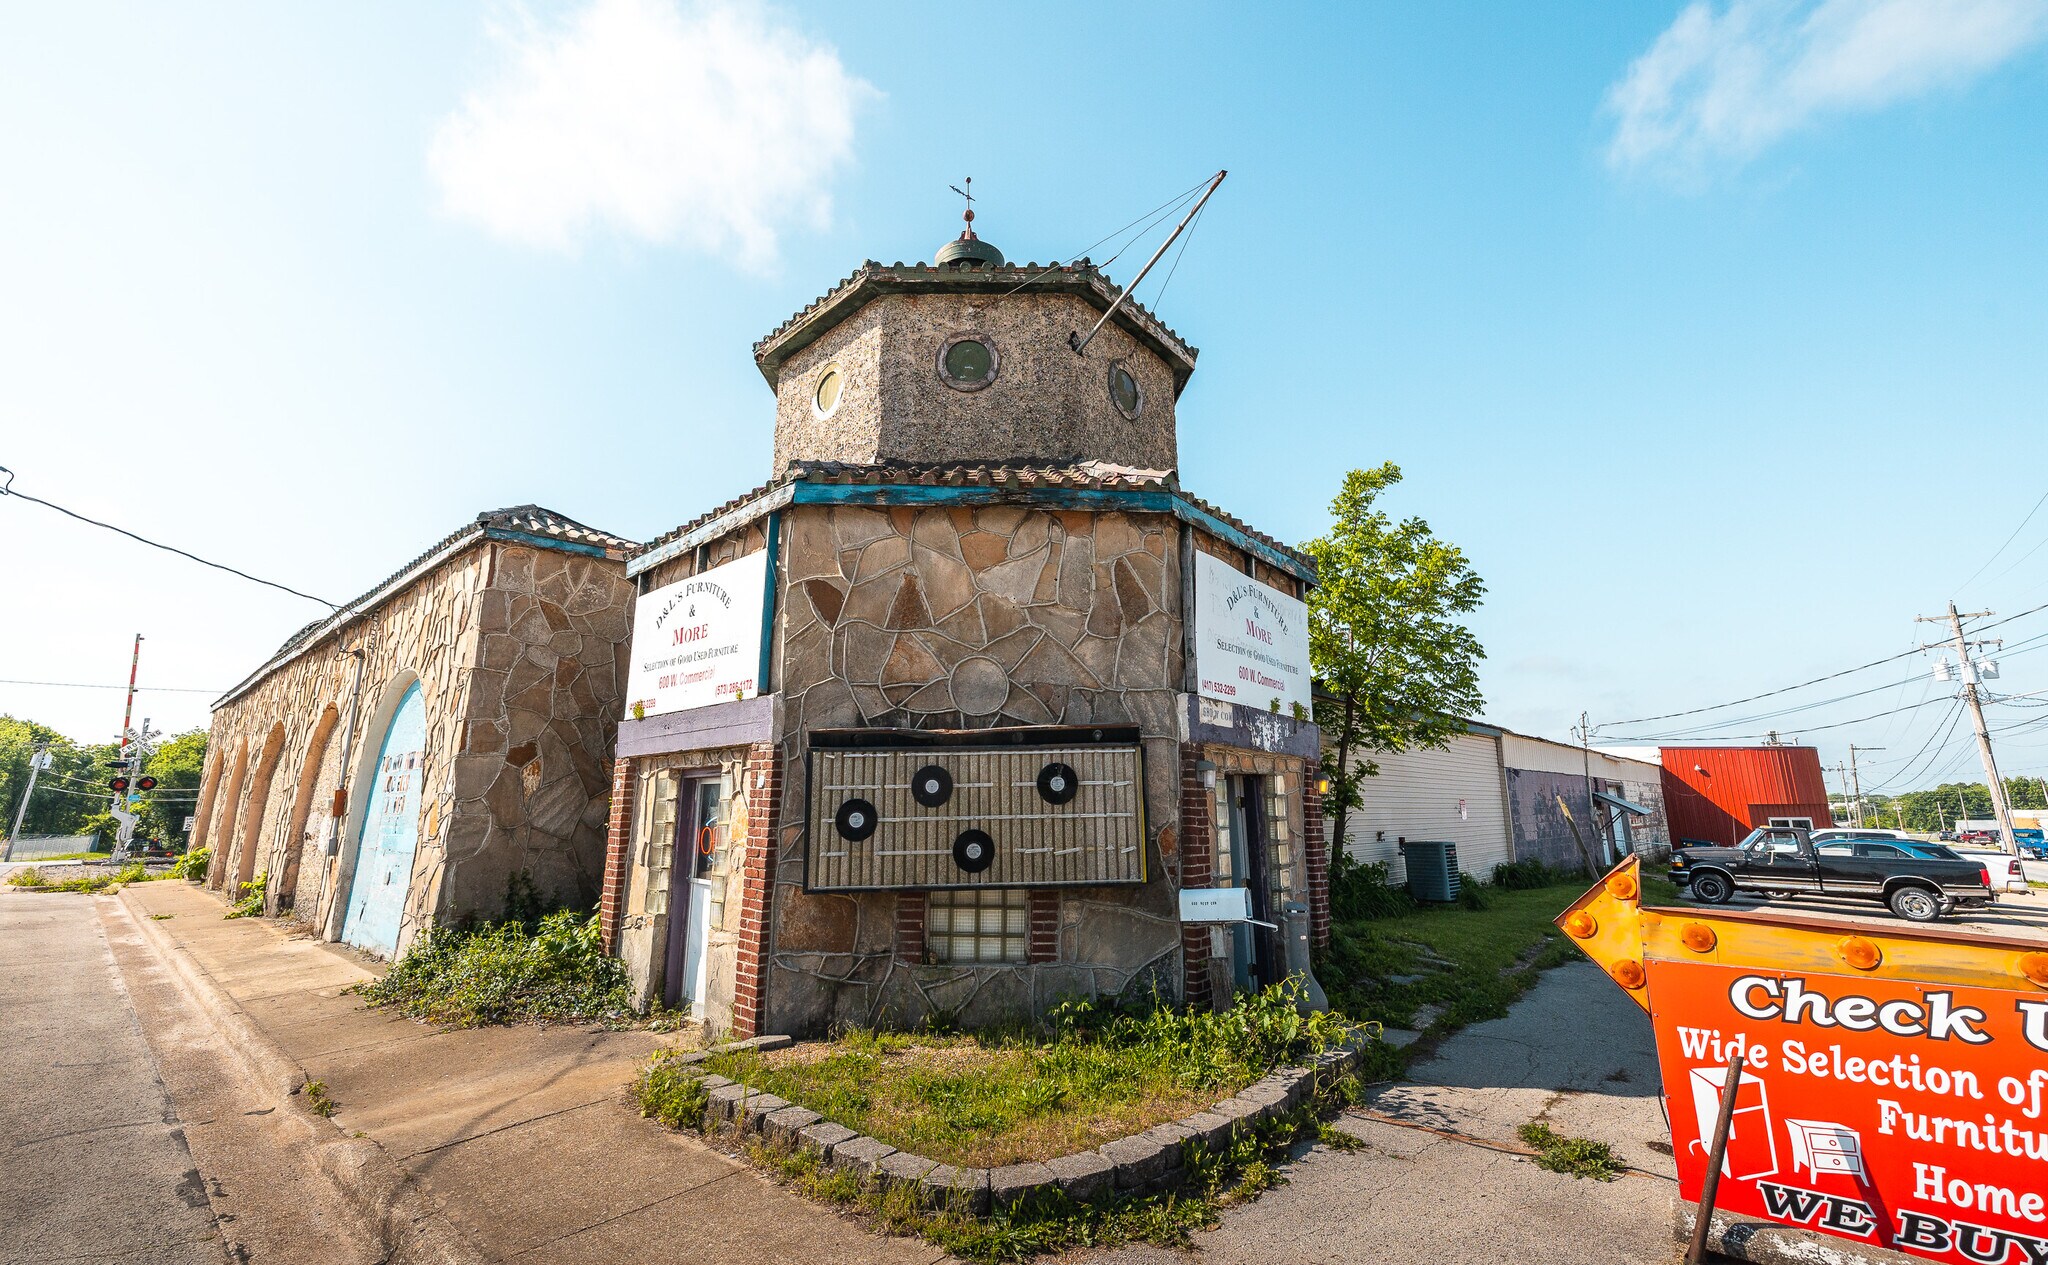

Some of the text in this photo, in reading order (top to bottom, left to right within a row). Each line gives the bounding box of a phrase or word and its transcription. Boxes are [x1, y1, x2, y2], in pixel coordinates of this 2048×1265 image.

[686, 581, 732, 609] FURNITURE
[689, 604, 695, 617] &
[1248, 584, 1289, 636] FURNITURE
[1254, 606, 1259, 619] &
[672, 623, 708, 646] MORE
[1246, 617, 1273, 646] MORE
[680, 665, 715, 685] Commercial
[1213, 682, 1236, 696] 532-2299
[1238, 665, 1249, 681] 600
[1257, 671, 1286, 692] Commercial
[1729, 975, 2048, 1053] Check U
[1677, 1026, 2048, 1118] Wide Selection of
[1877, 1098, 2048, 1161] Furnitu
[1912, 1162, 2047, 1222] Home
[1756, 1180, 1878, 1237] WE
